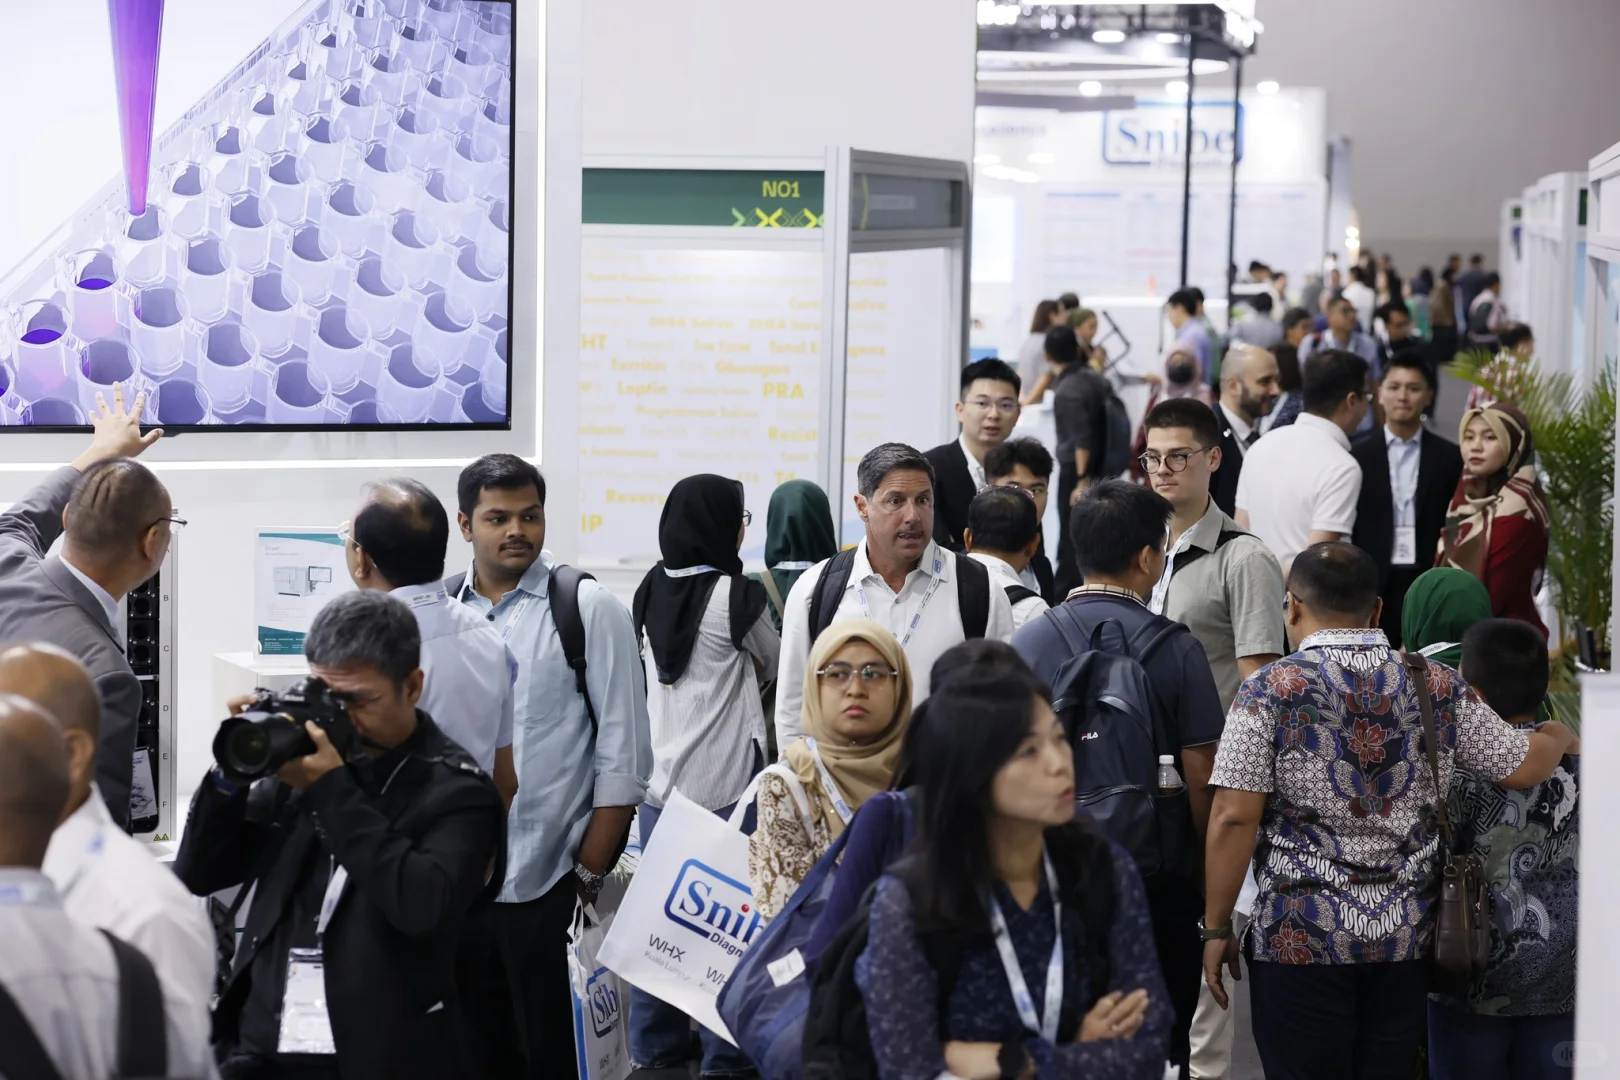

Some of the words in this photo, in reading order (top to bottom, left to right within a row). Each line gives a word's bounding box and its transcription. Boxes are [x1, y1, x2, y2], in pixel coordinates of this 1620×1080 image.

[763, 382, 805, 399] PRA
[1081, 732, 1099, 741] FILA
[649, 933, 686, 963] WHX
